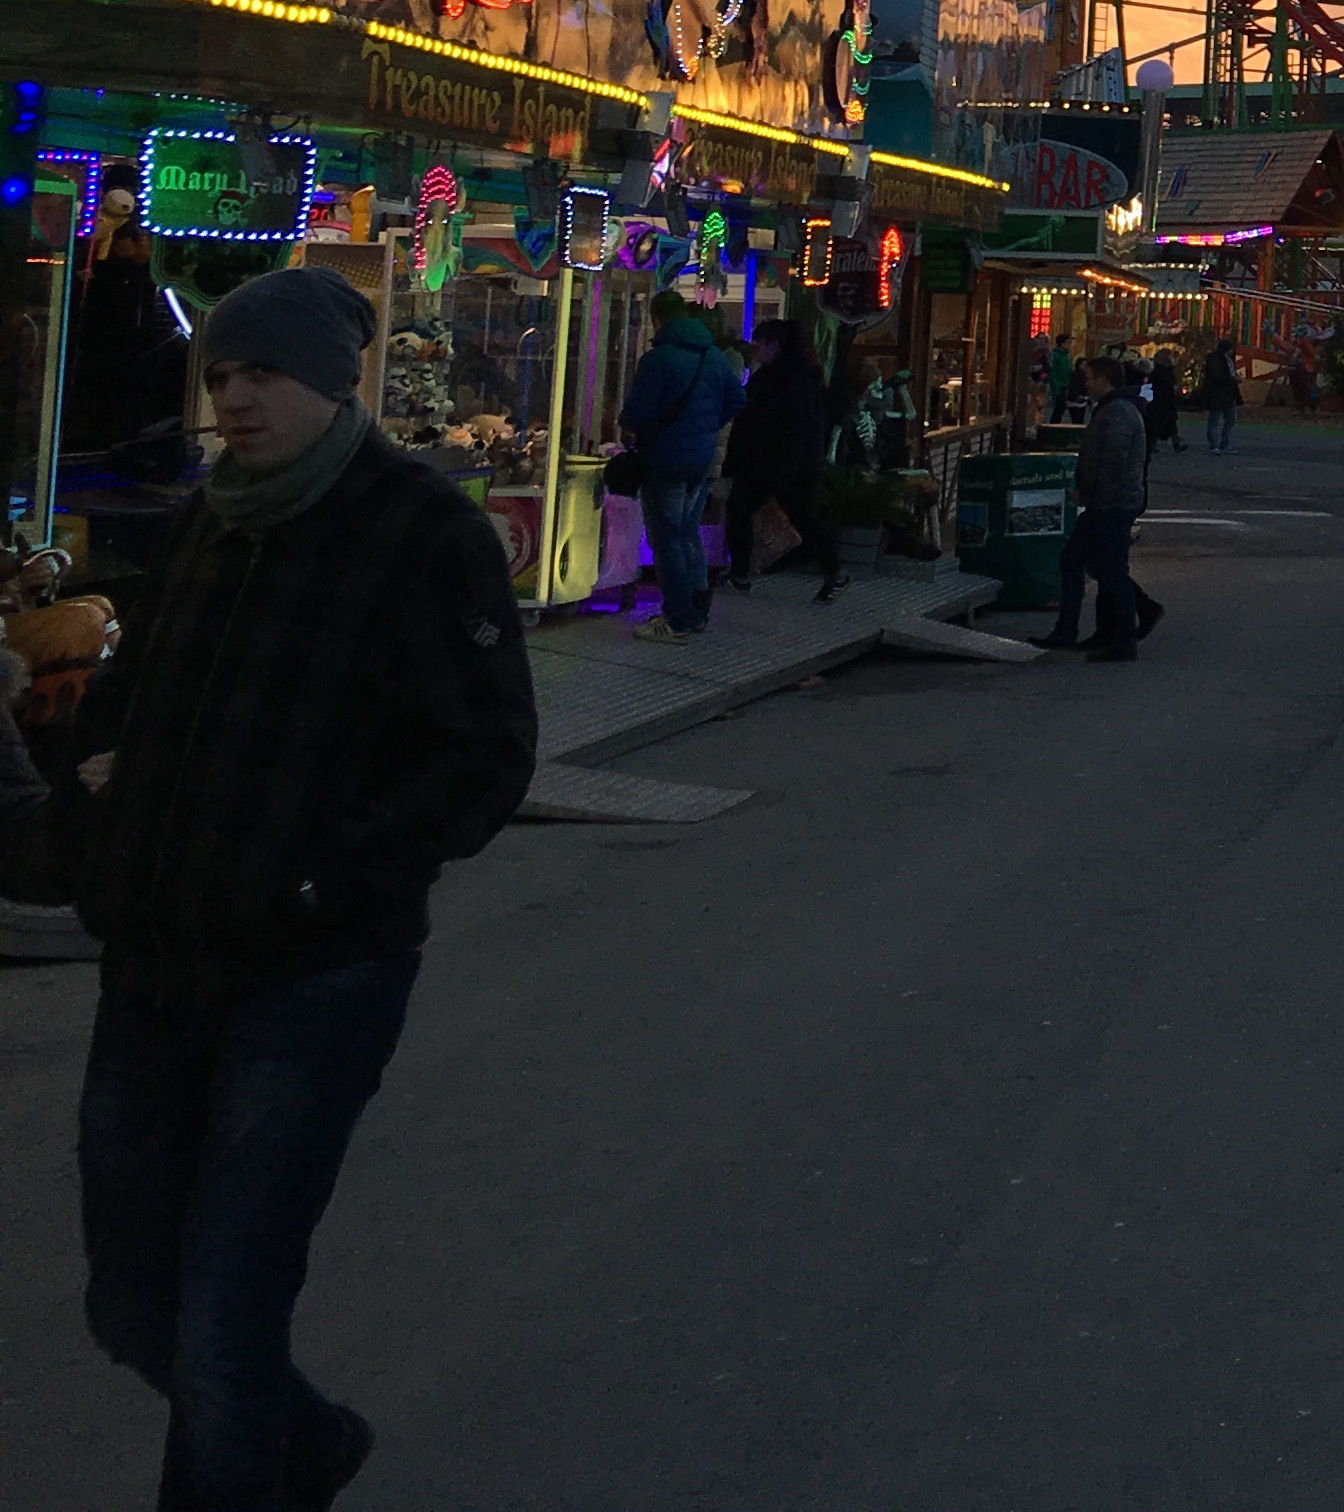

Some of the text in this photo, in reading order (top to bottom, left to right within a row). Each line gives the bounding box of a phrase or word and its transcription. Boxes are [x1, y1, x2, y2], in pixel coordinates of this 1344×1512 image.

[361, 39, 593, 154] Treasure Island
[156, 165, 229, 197] Mary
[1036, 144, 1109, 210] BAR
